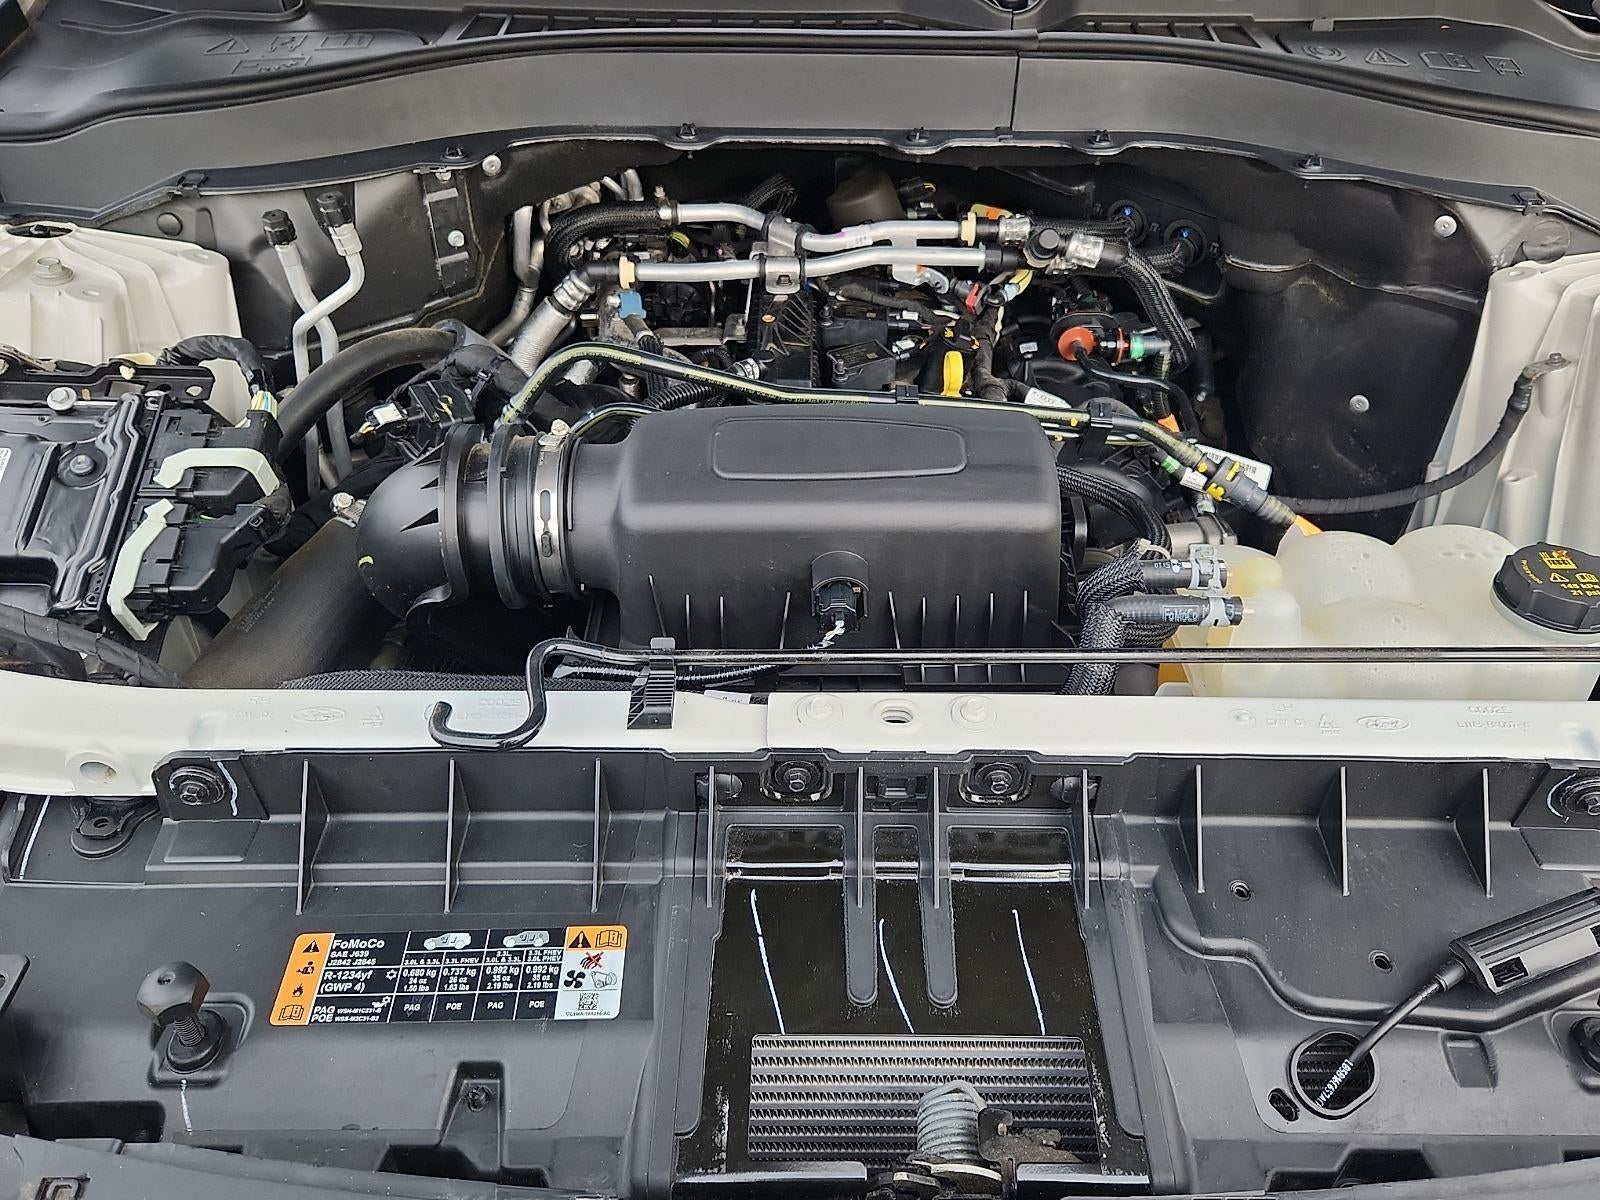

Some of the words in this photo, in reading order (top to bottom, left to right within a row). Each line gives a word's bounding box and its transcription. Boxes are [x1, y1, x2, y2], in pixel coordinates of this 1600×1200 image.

[1164, 606, 1200, 623] FoMoCo
[332, 938, 385, 949] FoMoCo
[426, 968, 437, 978] kg
[442, 968, 465, 976] 0.737
[466, 967, 476, 977] kg
[485, 966, 507, 974] 0.992
[509, 965, 519, 975] kg
[526, 966, 547, 974] 0.992
[549, 965, 559, 975] kg
[324, 970, 373, 981] R-1234yf
[320, 983, 352, 993] (GWP
[354, 982, 366, 993] 4)
[314, 1006, 335, 1014] PAG
[311, 1014, 334, 1022] POE
